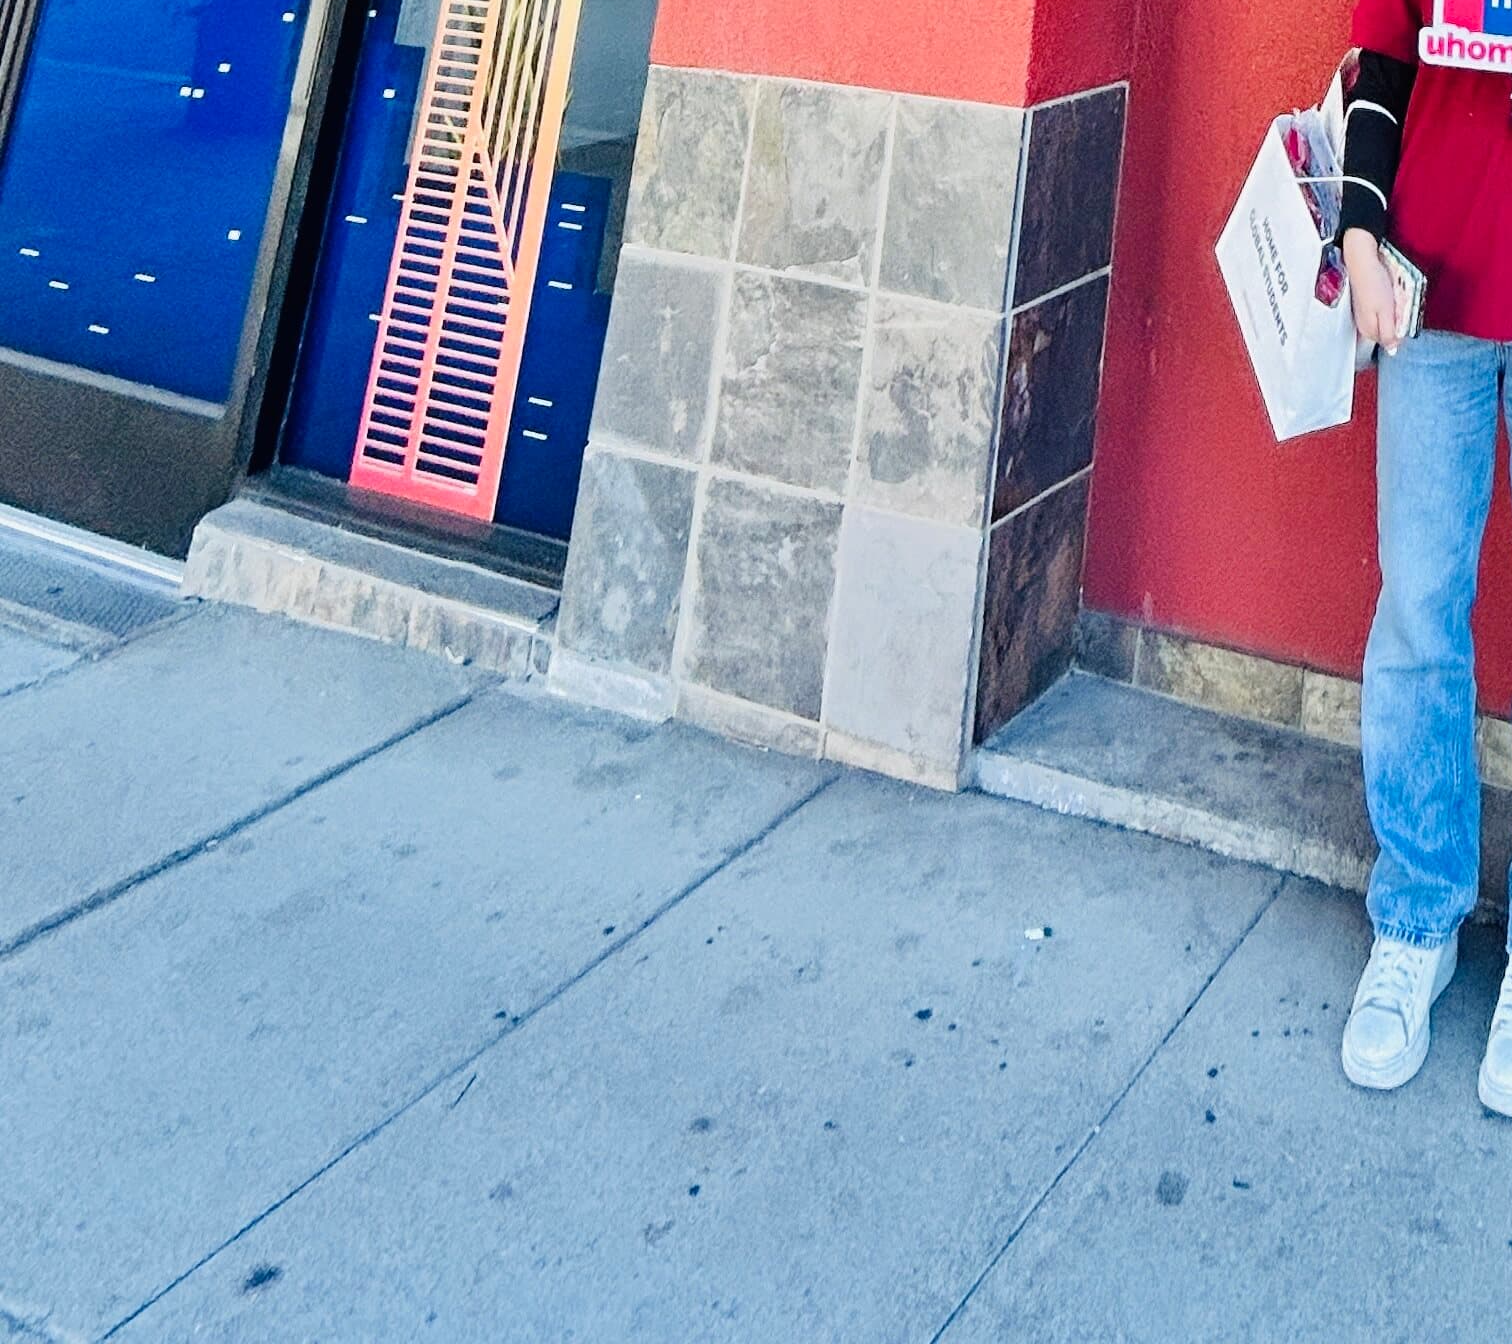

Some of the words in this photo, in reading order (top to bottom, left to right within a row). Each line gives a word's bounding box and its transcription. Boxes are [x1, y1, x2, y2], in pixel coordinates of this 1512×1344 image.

[1249, 208, 1265, 267] GLOBAL
[1262, 264, 1288, 347] STUDENTS
[1262, 216, 1279, 261] HOME
[1274, 263, 1289, 296] FOR
